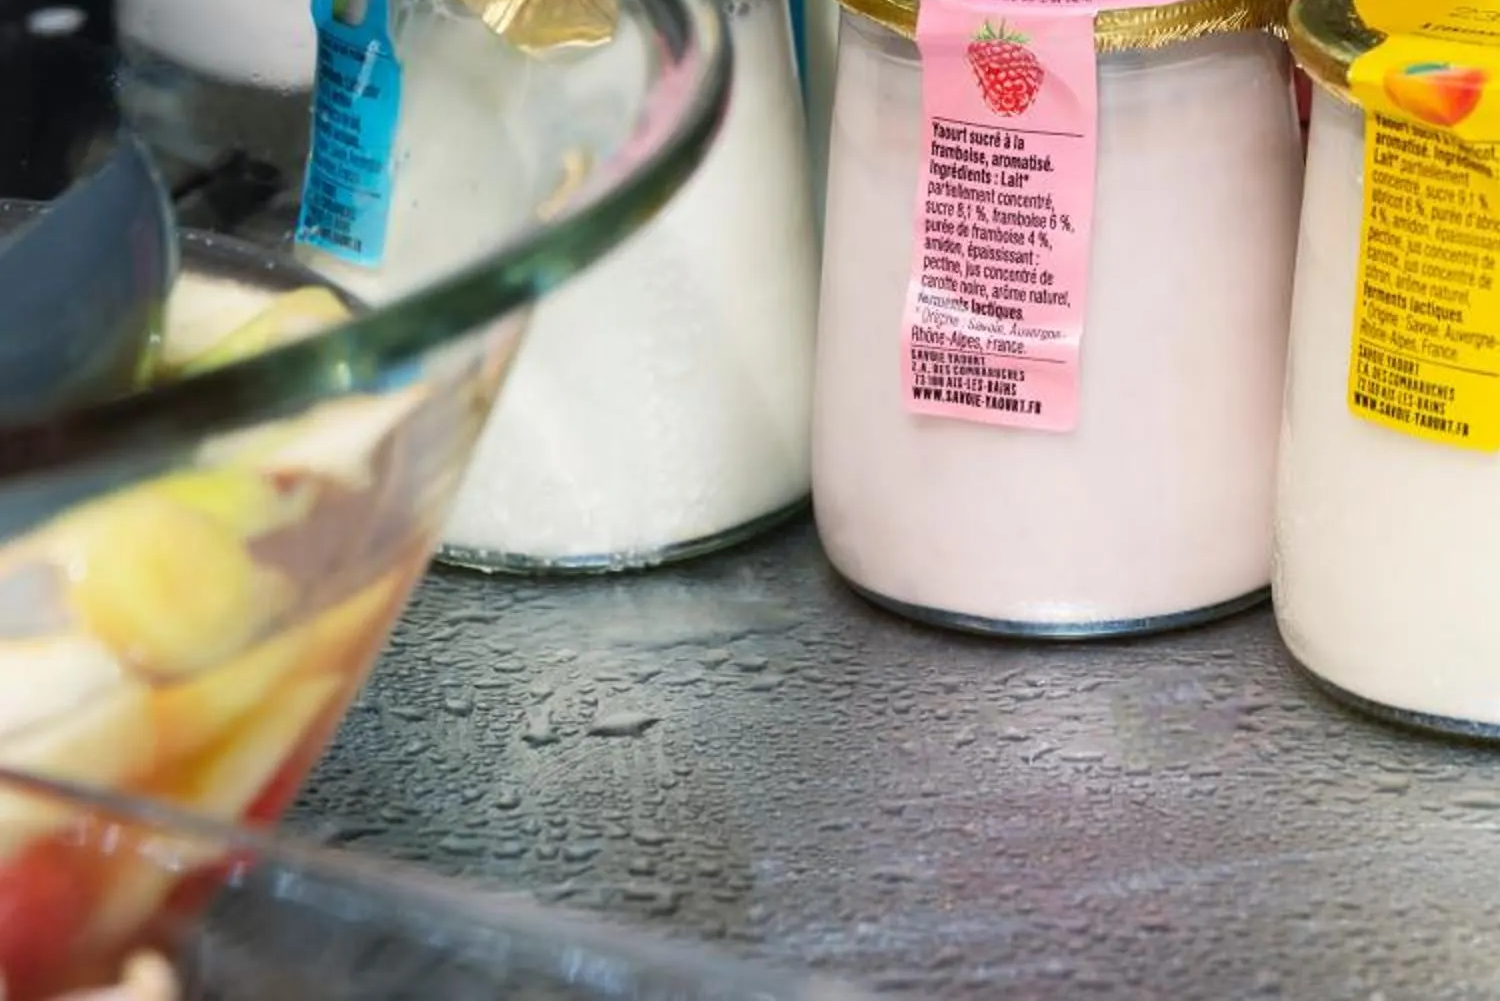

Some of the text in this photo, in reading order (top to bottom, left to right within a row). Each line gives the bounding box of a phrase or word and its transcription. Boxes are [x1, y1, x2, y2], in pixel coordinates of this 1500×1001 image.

[932, 121, 1025, 150] Yaourt sucré à la
[931, 140, 1054, 172] framboise, aromatisé.
[929, 160, 991, 184] Ingrédients
[925, 200, 954, 216] sucre
